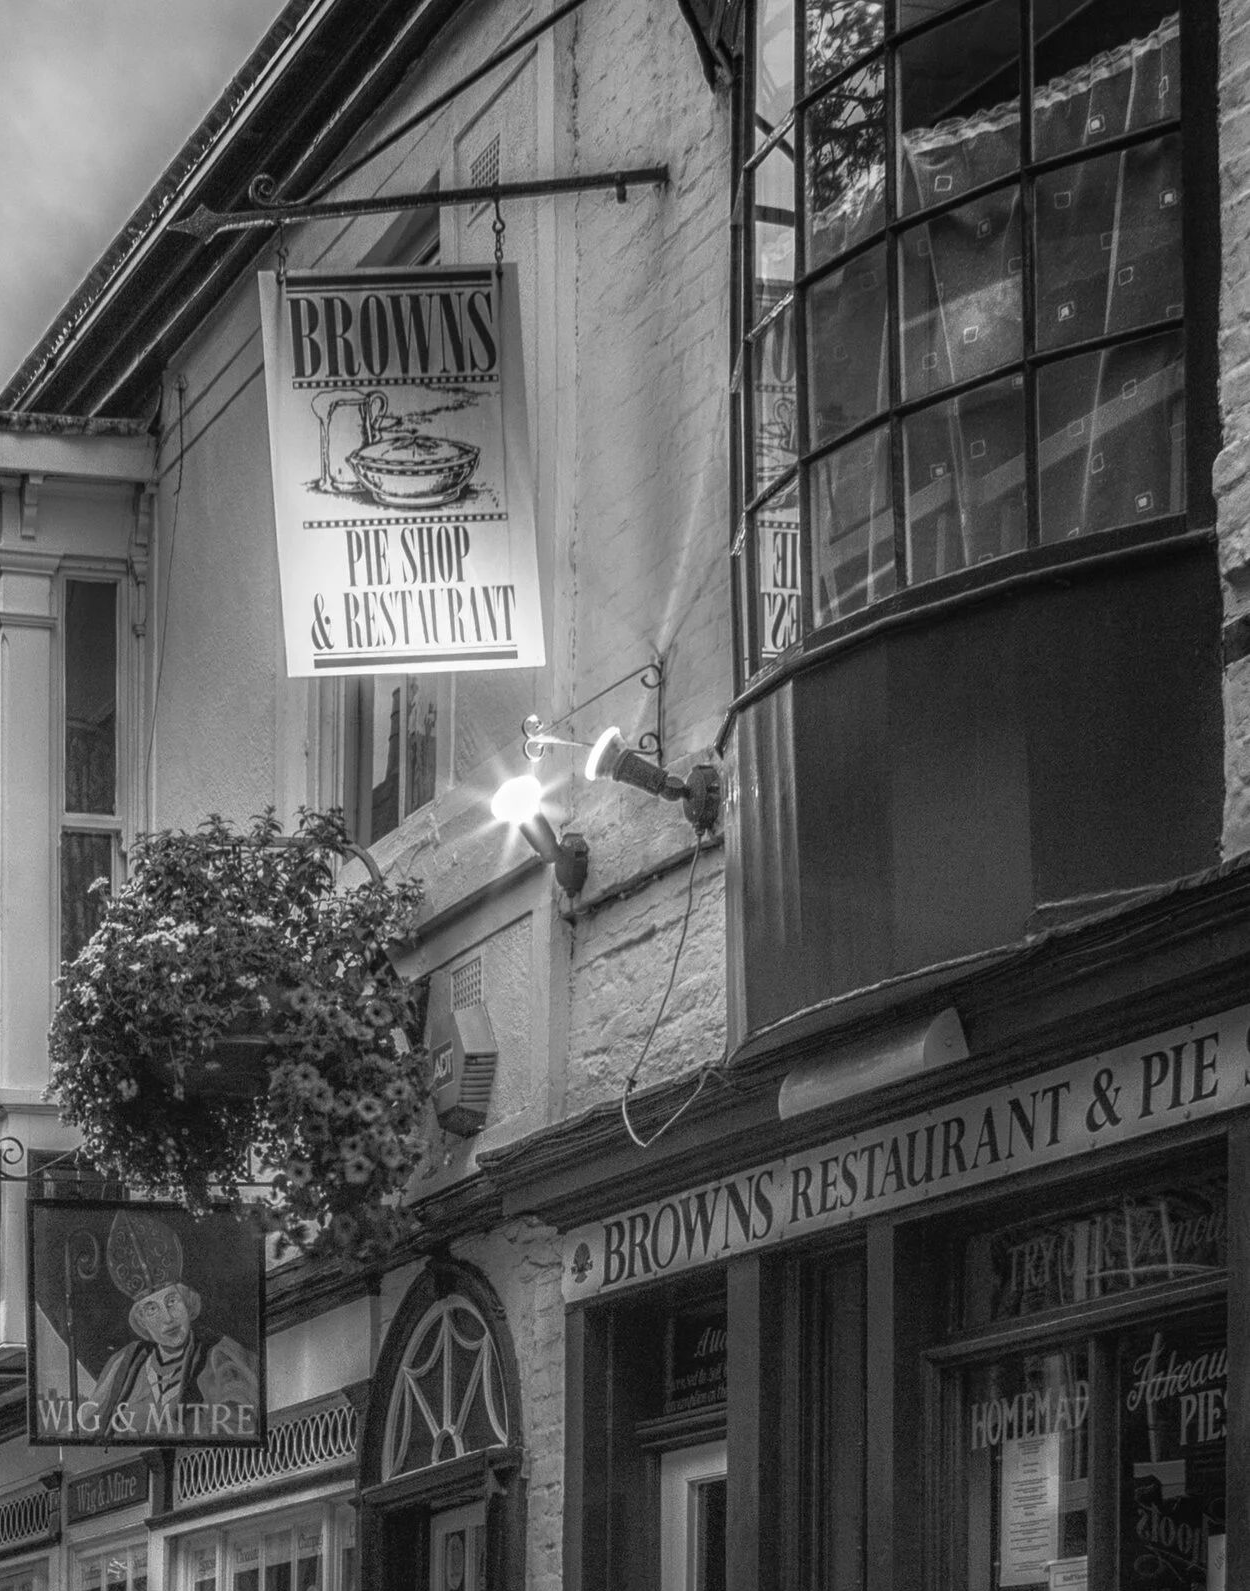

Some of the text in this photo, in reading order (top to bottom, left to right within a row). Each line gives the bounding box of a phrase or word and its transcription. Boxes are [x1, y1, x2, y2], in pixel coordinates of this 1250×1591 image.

[287, 291, 497, 378] BROWNS
[345, 525, 471, 587] PIE SHOP
[310, 584, 517, 651] & RESTAURANT
[434, 1048, 454, 1079] ADT
[602, 1168, 775, 1288] BROWNS
[789, 1081, 1071, 1225] RESTAURANT
[1085, 1067, 1122, 1133] &
[1138, 1032, 1220, 1120] PIE
[1127, 1346, 1227, 1411] Takeaw
[37, 1400, 255, 1435] WIG & MITRE
[971, 1379, 1090, 1450] HOMEMAD
[76, 1482, 97, 1513] Wig
[106, 1472, 137, 1504] Mitre
